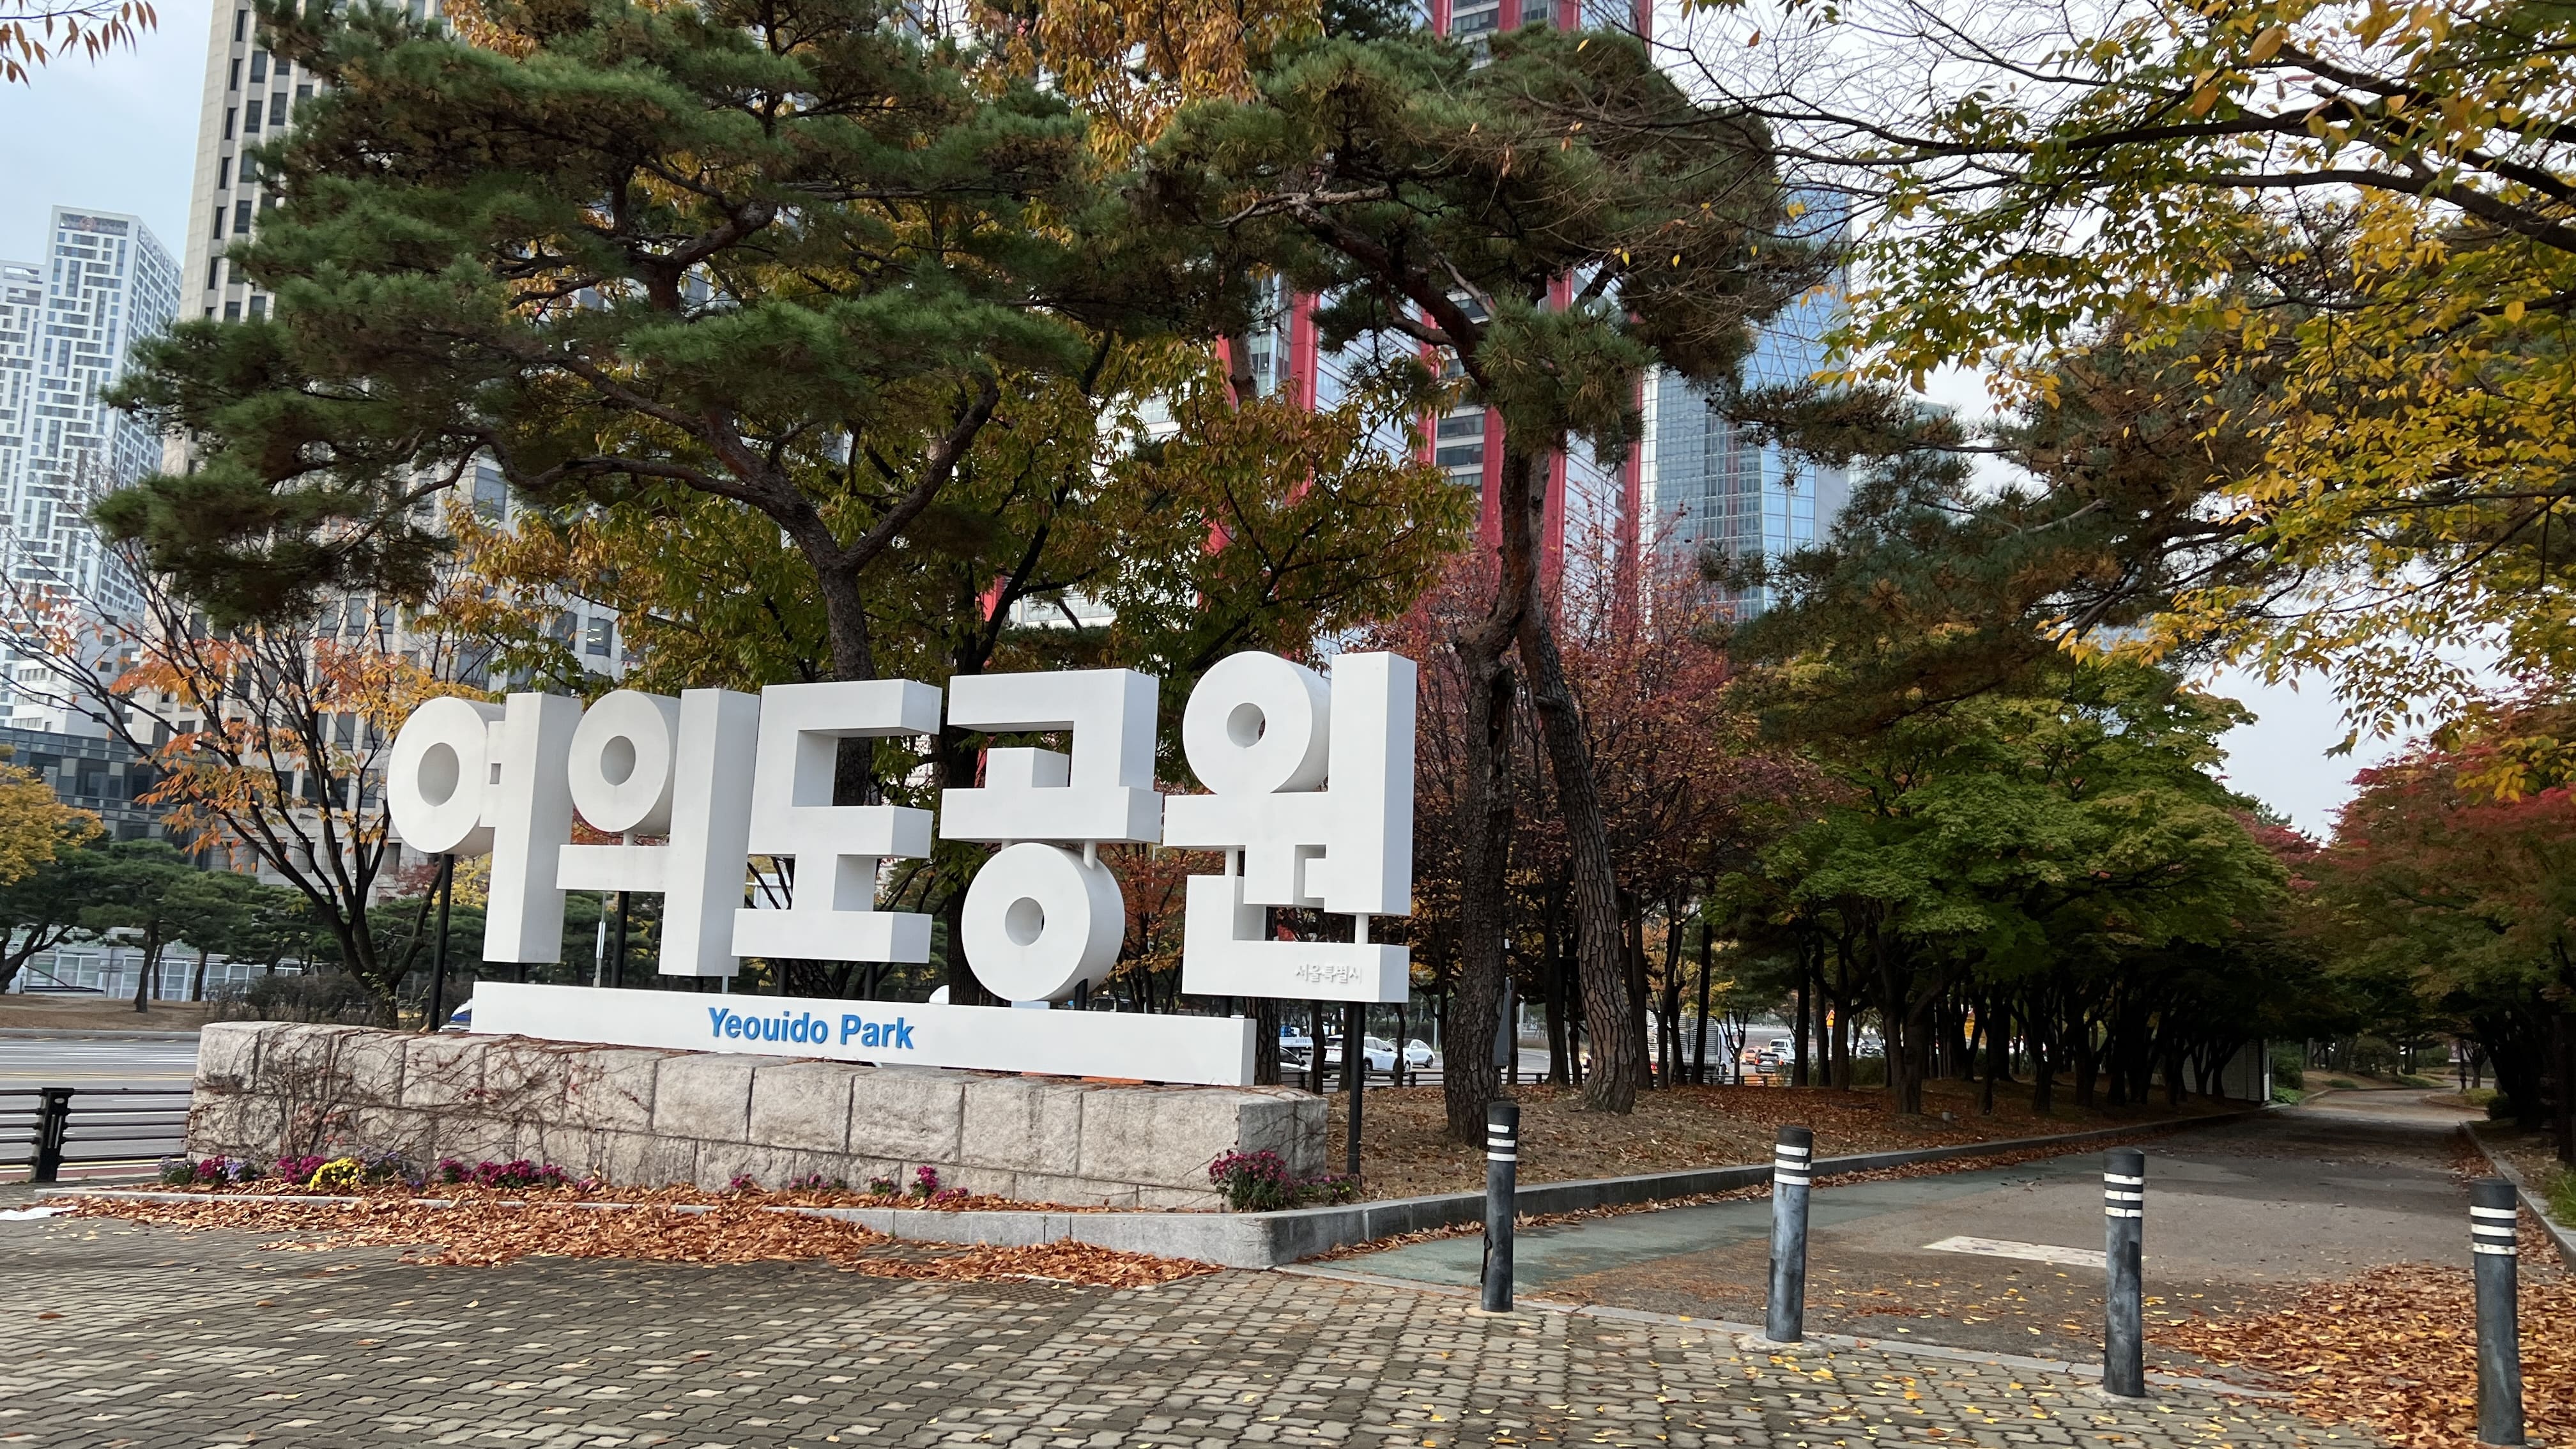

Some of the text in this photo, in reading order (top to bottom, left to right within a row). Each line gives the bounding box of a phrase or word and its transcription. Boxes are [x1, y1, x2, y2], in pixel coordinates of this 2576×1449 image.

[387, 650, 1418, 1002] 여의도공원
[1296, 963, 1363, 985] 서울특별시
[707, 1007, 915, 1049] Yeouido Park
